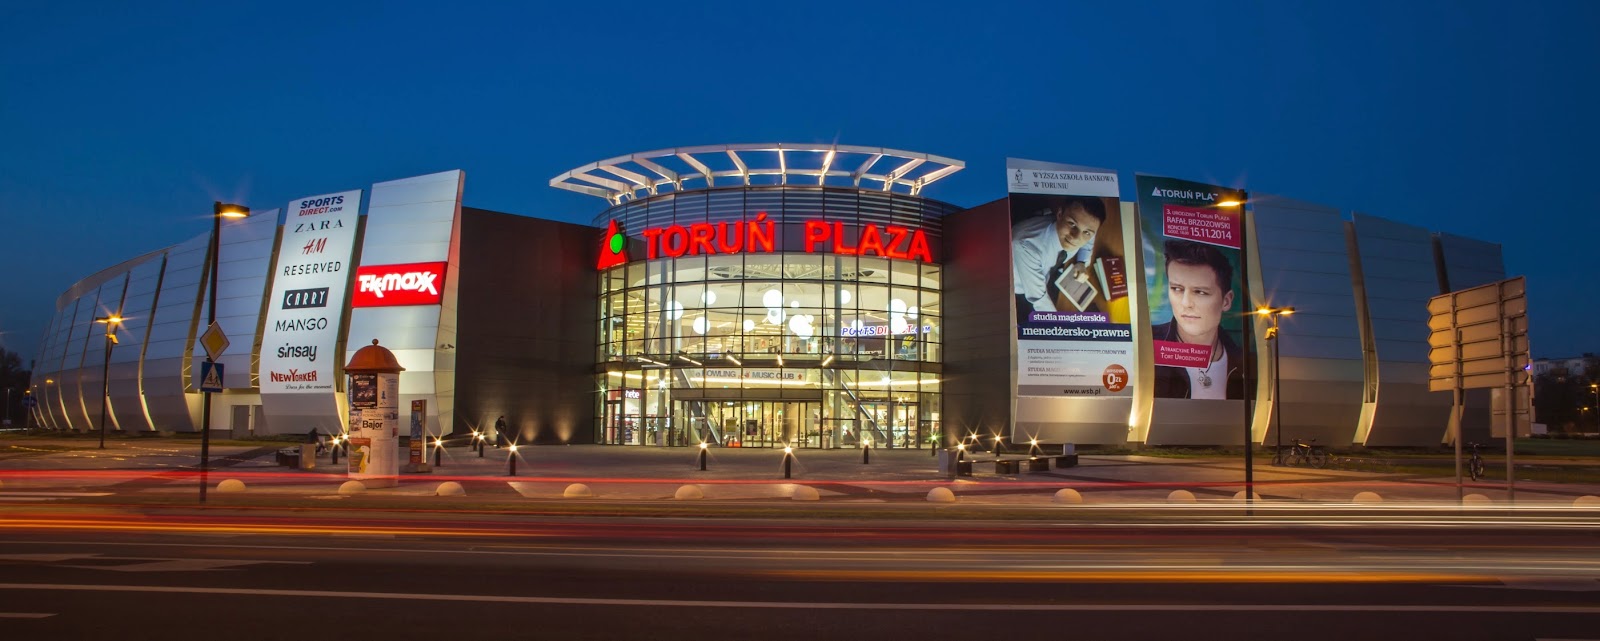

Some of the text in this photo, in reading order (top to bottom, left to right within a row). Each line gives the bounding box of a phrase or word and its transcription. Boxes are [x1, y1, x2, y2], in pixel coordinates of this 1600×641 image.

[1033, 171, 1059, 180] WYŻSZA
[1060, 173, 1083, 181] SZKOŁA
[1161, 189, 1218, 201] TORUŃ PLA
[300, 195, 344, 209] SPORTS
[294, 219, 344, 233] ZARA
[1166, 216, 1230, 229] RAFAŁ BRZOZOWSKI
[643, 211, 932, 263] TORUŃ PLAZA
[1190, 227, 1232, 240] 15.11.2014
[302, 237, 328, 255] H&M
[283, 261, 342, 276] RESERVED
[286, 291, 326, 306] CARRY
[1033, 313, 1106, 322] studia magisterskie
[275, 317, 328, 332] MANGO
[1022, 326, 1130, 338] menedżersko-prawne
[277, 343, 317, 362] sinsay
[752, 371, 794, 380] MUSIC CLUB
[1063, 387, 1101, 396] www.wsb.pl
[362, 420, 383, 430] Bajor
